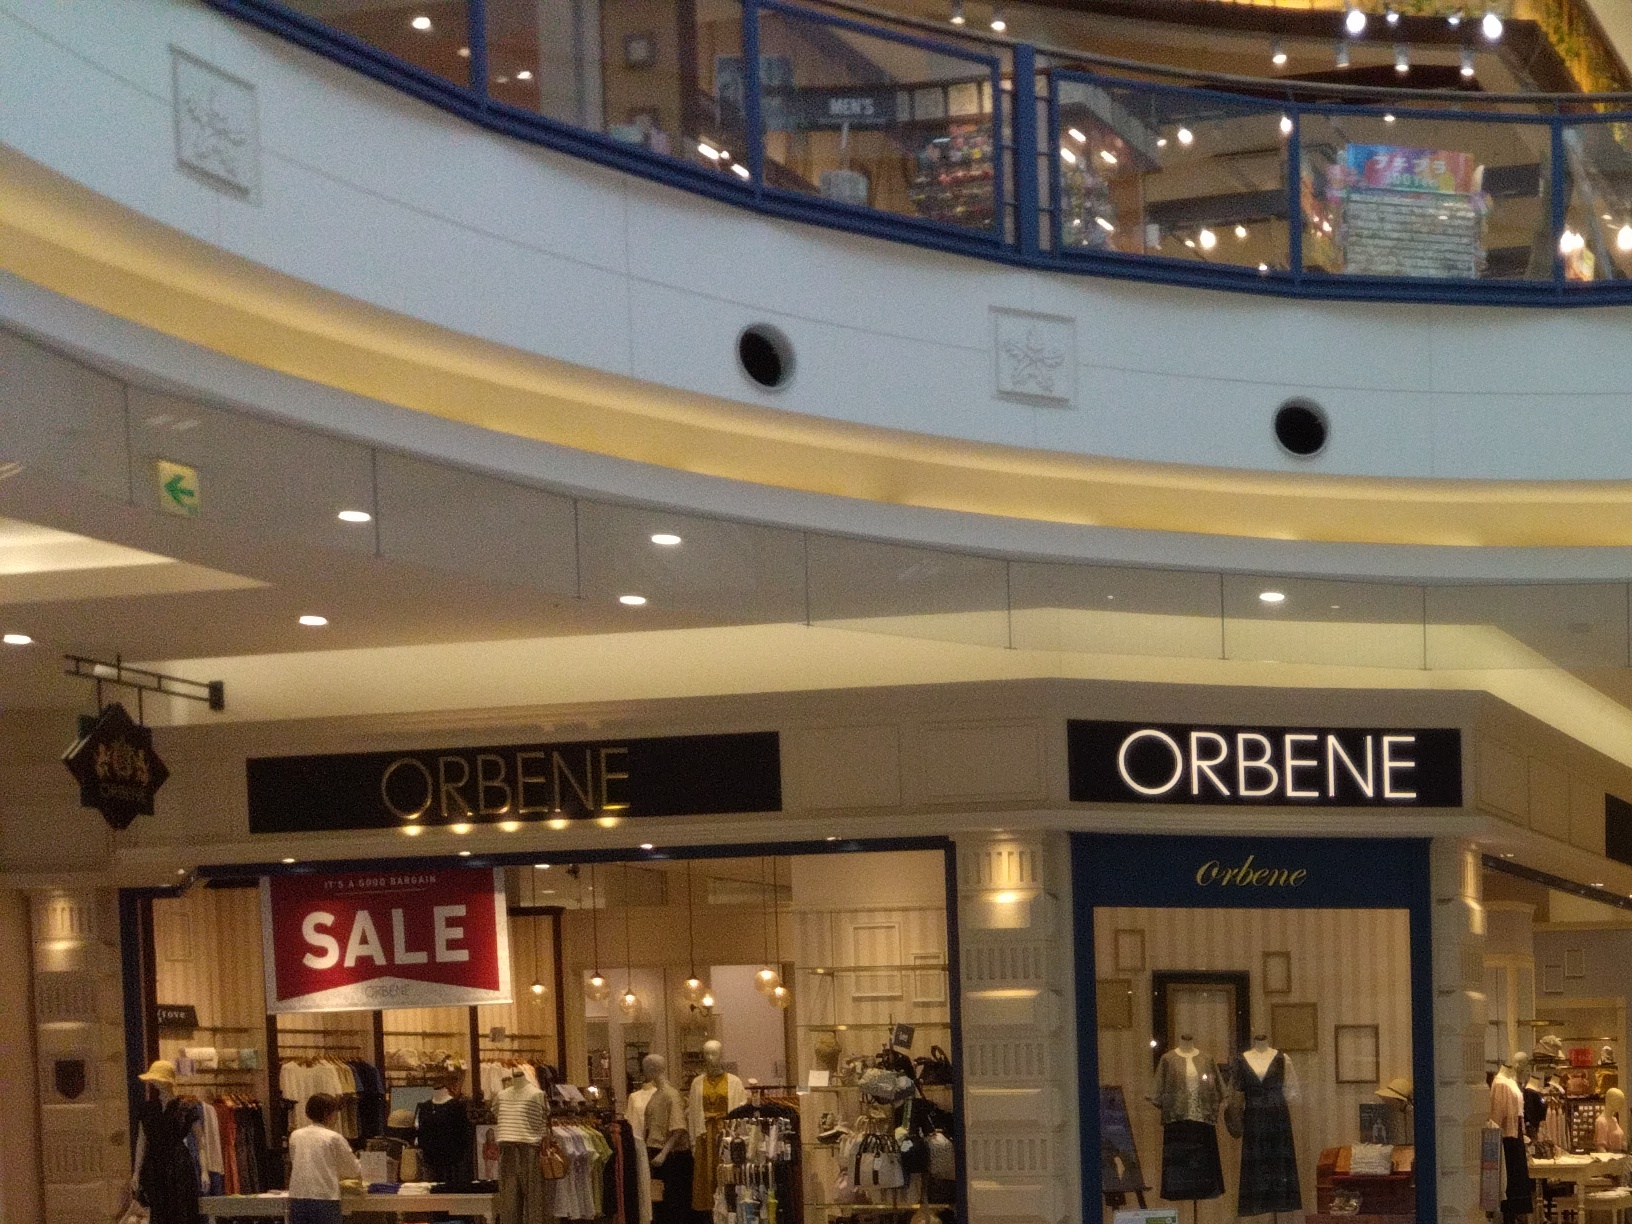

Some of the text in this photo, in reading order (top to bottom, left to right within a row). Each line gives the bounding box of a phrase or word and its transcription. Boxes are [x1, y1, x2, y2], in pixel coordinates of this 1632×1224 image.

[381, 746, 631, 820] ORBENE
[1117, 729, 1417, 799] ORBENE
[389, 874, 437, 886] BARGAIN
[1195, 854, 1308, 887] Orbene
[302, 904, 470, 970] SALE
